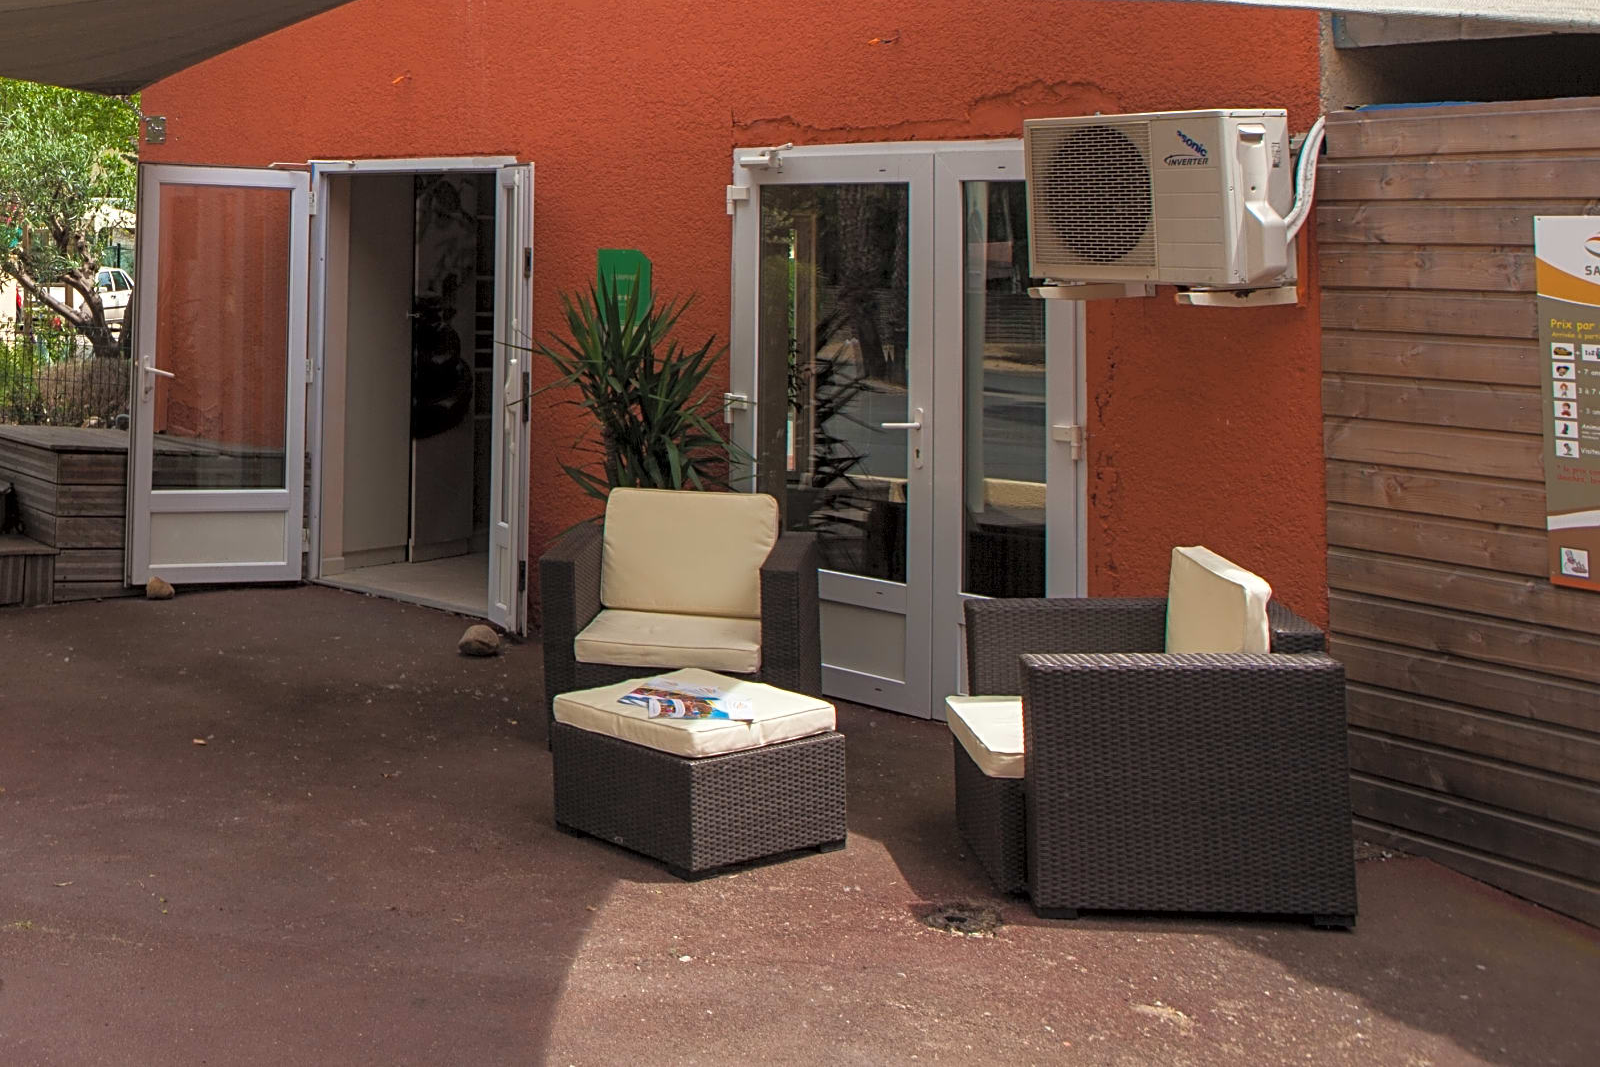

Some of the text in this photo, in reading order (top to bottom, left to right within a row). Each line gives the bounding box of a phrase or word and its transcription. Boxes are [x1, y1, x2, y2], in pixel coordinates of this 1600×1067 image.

[1167, 157, 1209, 166] INVERTER
[1550, 318, 1595, 332] Prix par
